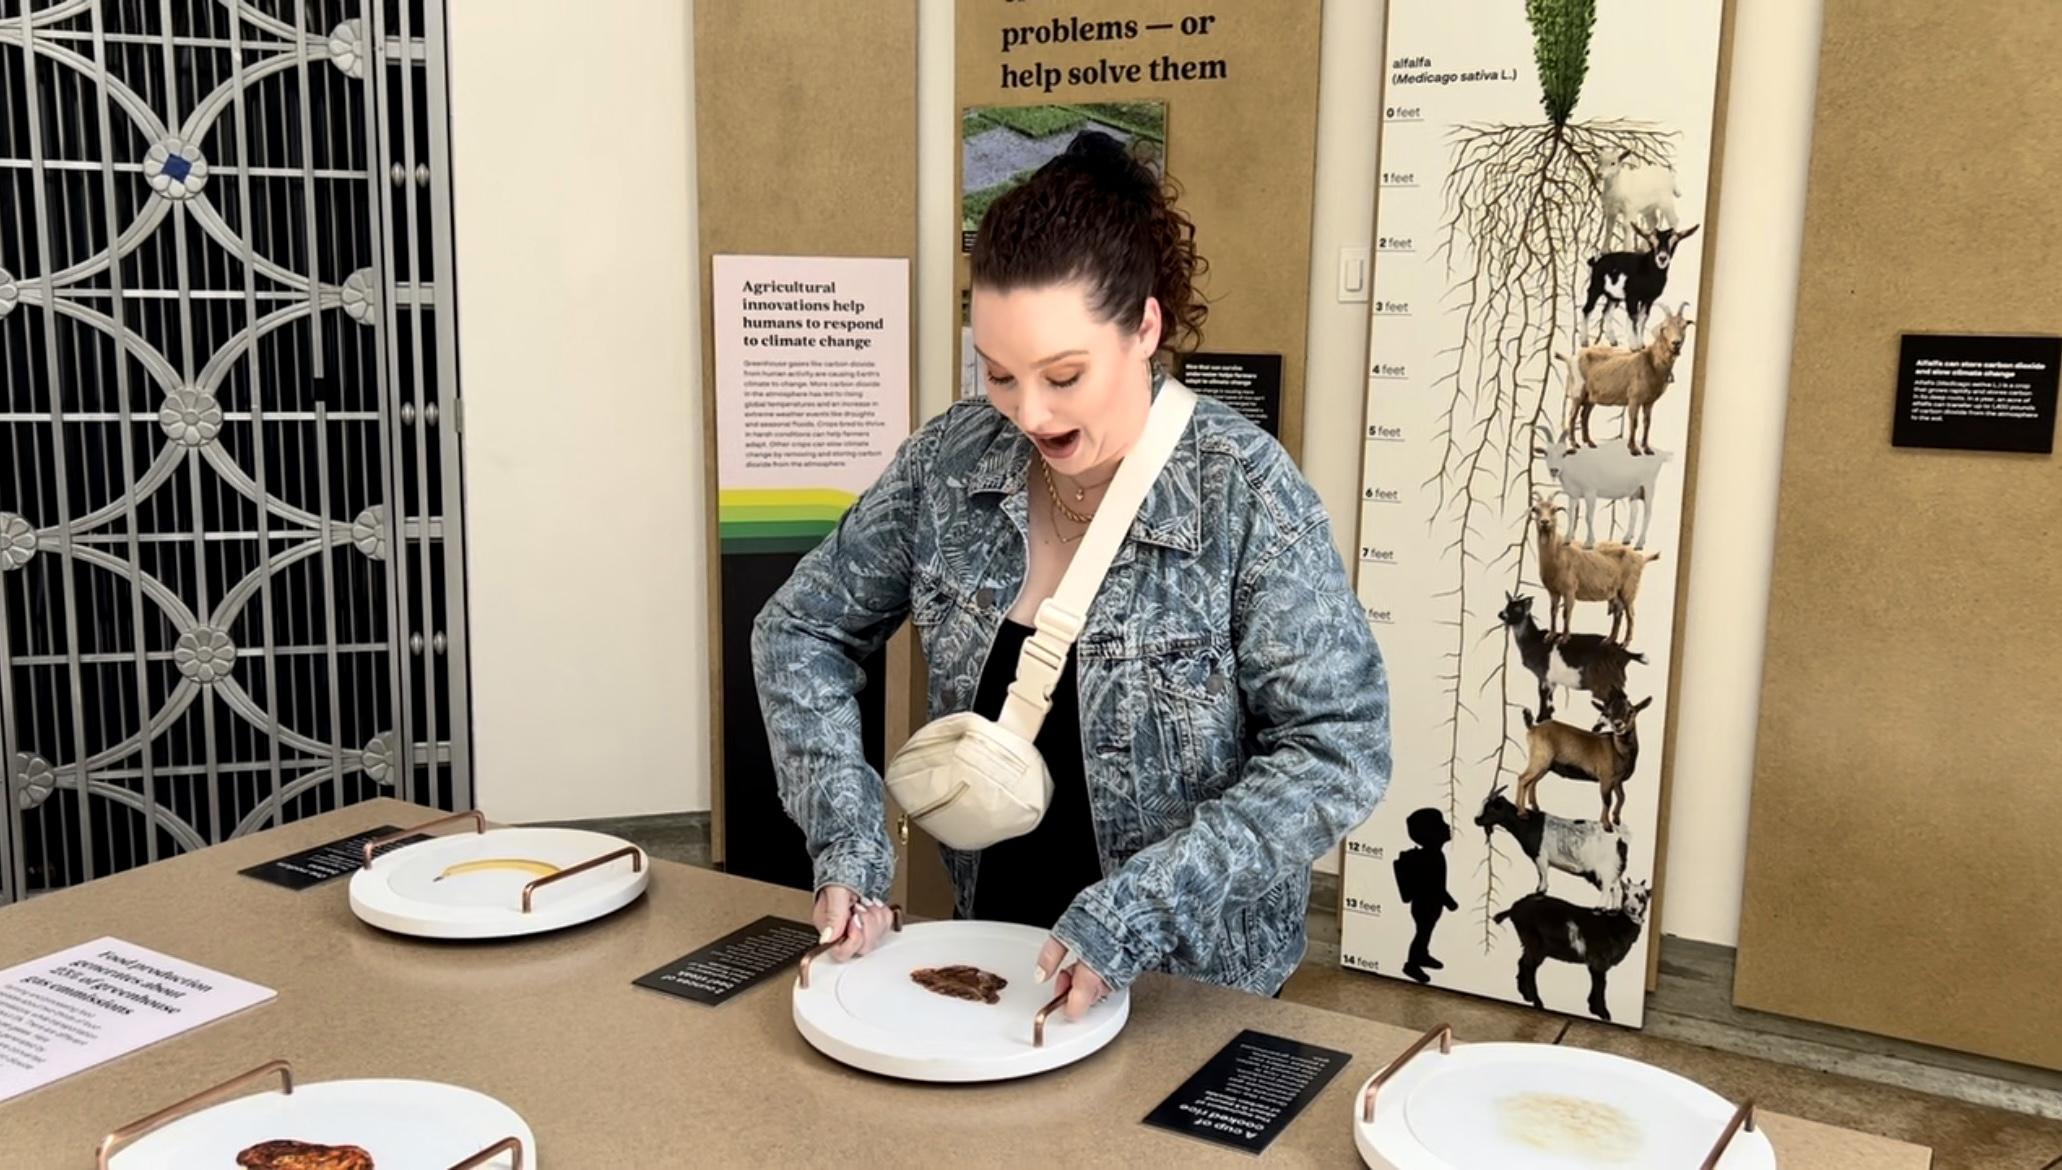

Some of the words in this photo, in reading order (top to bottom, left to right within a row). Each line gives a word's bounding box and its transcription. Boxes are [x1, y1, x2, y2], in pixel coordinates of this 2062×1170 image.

[1001, 17, 1138, 52] problems
[1180, 15, 1216, 35] or
[1392, 57, 1431, 69] alfalfa
[1001, 62, 1062, 93] help
[1068, 59, 1142, 85] solve
[1149, 56, 1227, 82] them
[1392, 71, 1457, 86] (Medicago
[1461, 69, 1498, 82] sativa
[1501, 68, 1518, 81] L.)
[1386, 107, 1395, 118] 0
[1396, 107, 1420, 117] feet
[1383, 173, 1388, 183] 1
[1390, 172, 1414, 183] feet
[1379, 237, 1387, 248] 2
[1389, 237, 1412, 248] feet
[742, 280, 836, 295] Agricultural
[742, 298, 830, 311] innovations
[833, 300, 865, 314] help
[1376, 301, 1383, 312] 3
[1385, 301, 1409, 312] feet
[742, 316, 803, 329] humans
[806, 318, 821, 329] to
[823, 317, 884, 332] respond
[743, 336, 759, 346] to
[761, 334, 816, 347] climate
[819, 335, 871, 350] change
[1372, 365, 1380, 375] 4
[1382, 364, 1405, 376] feet
[1369, 425, 1376, 436] 5
[1378, 426, 1401, 437] feet
[1365, 488, 1373, 498] 6
[1374, 488, 1398, 499] feet
[1362, 547, 1369, 557] 7
[1371, 548, 1394, 560] feet
[1368, 609, 1391, 620] feet
[1348, 841, 1359, 852] 12
[1362, 843, 1383, 856] feet
[1346, 898, 1357, 908] 13
[1359, 900, 1381, 913] feet
[1343, 954, 1355, 965] 14
[1357, 957, 1379, 970] feet
[98, 950, 138, 966] Food
[128, 961, 213, 992] production
[19, 975, 50, 987] gas
[69, 959, 143, 985] generates
[141, 983, 187, 999] about
[1179, 1104, 1208, 1116] rice
[1193, 1118, 1212, 1127] of
[1208, 1112, 1264, 1131] cooked
[1214, 1122, 1243, 1135] cup
[1245, 1130, 1258, 1139] A
